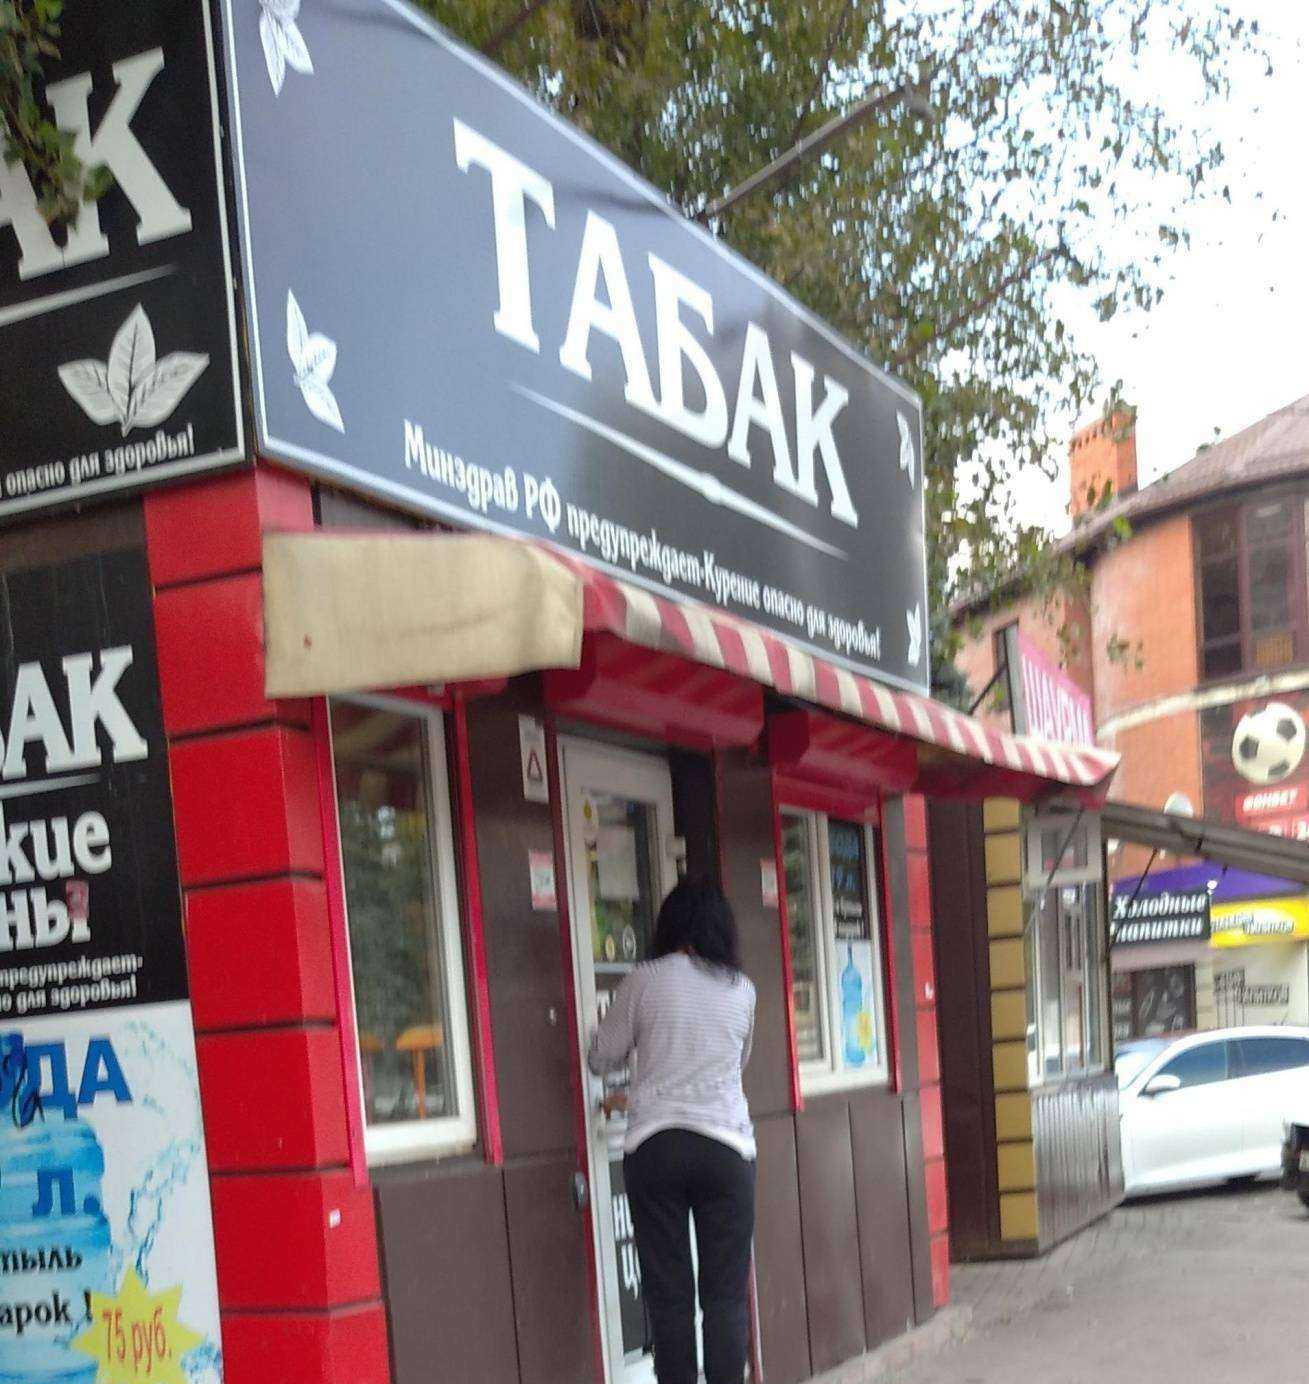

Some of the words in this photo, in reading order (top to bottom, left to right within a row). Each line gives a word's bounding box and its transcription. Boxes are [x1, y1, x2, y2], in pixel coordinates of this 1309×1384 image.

[453, 117, 858, 529] ТАБАК
[6, 460, 65, 496] опасно
[69, 452, 100, 486] для
[104, 422, 195, 476] здоровья!
[404, 418, 519, 514] Минздрав
[522, 472, 562, 534] РФ
[763, 584, 804, 626] опасно
[807, 604, 826, 639] для
[827, 612, 881, 662] здоровья!
[0, 644, 148, 780] АК
[17, 988, 47, 1014] для
[51, 973, 137, 1008] здоровья!
[102, 1306, 126, 1363] 75
[131, 1303, 172, 1375] руб.
